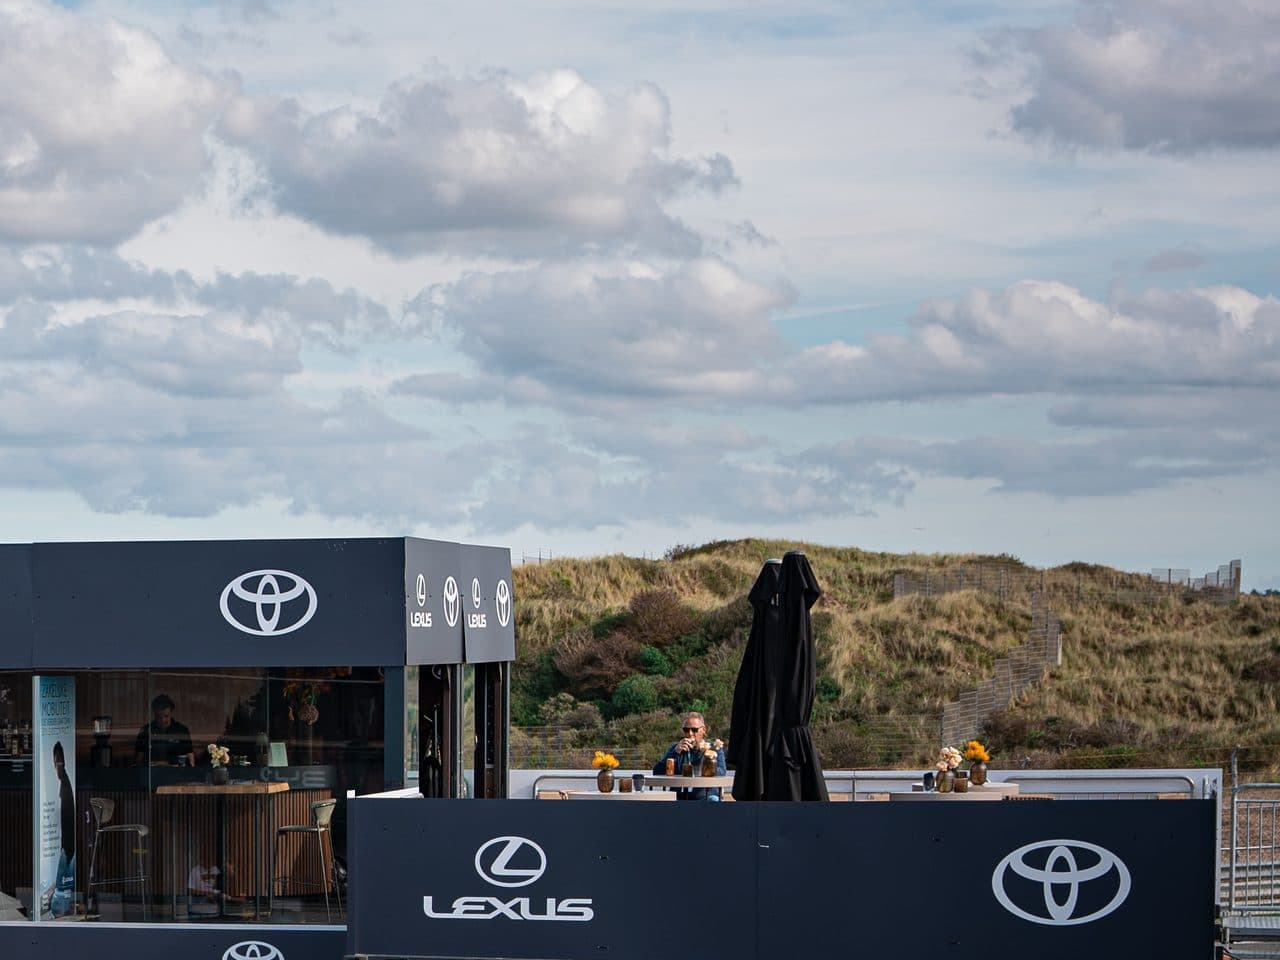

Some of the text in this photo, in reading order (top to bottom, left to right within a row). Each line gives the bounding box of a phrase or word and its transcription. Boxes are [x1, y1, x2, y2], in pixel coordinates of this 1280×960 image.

[410, 612, 433, 627] LEXUS
[467, 614, 487, 628] LEXUS
[423, 895, 595, 921] LEXUS
